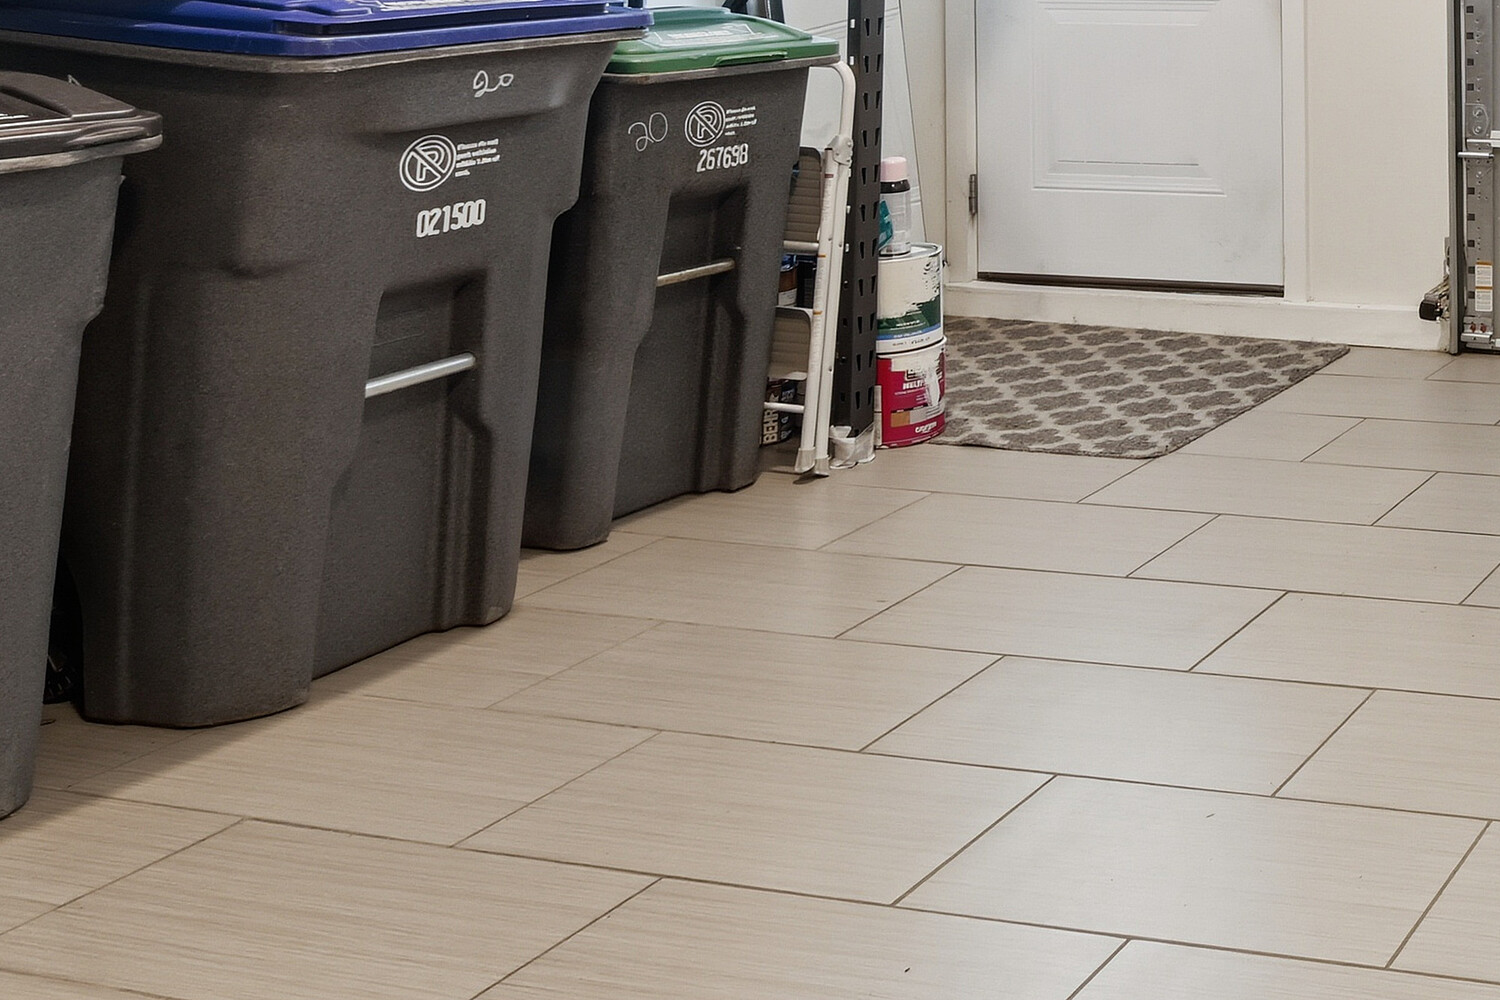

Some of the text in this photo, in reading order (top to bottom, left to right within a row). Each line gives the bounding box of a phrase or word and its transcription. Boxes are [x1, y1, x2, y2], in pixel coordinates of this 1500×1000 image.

[472, 70, 514, 98] 20
[628, 112, 668, 152] 20
[696, 143, 749, 173] 267698
[416, 199, 486, 238] 021500
[763, 409, 779, 445] BEHR
